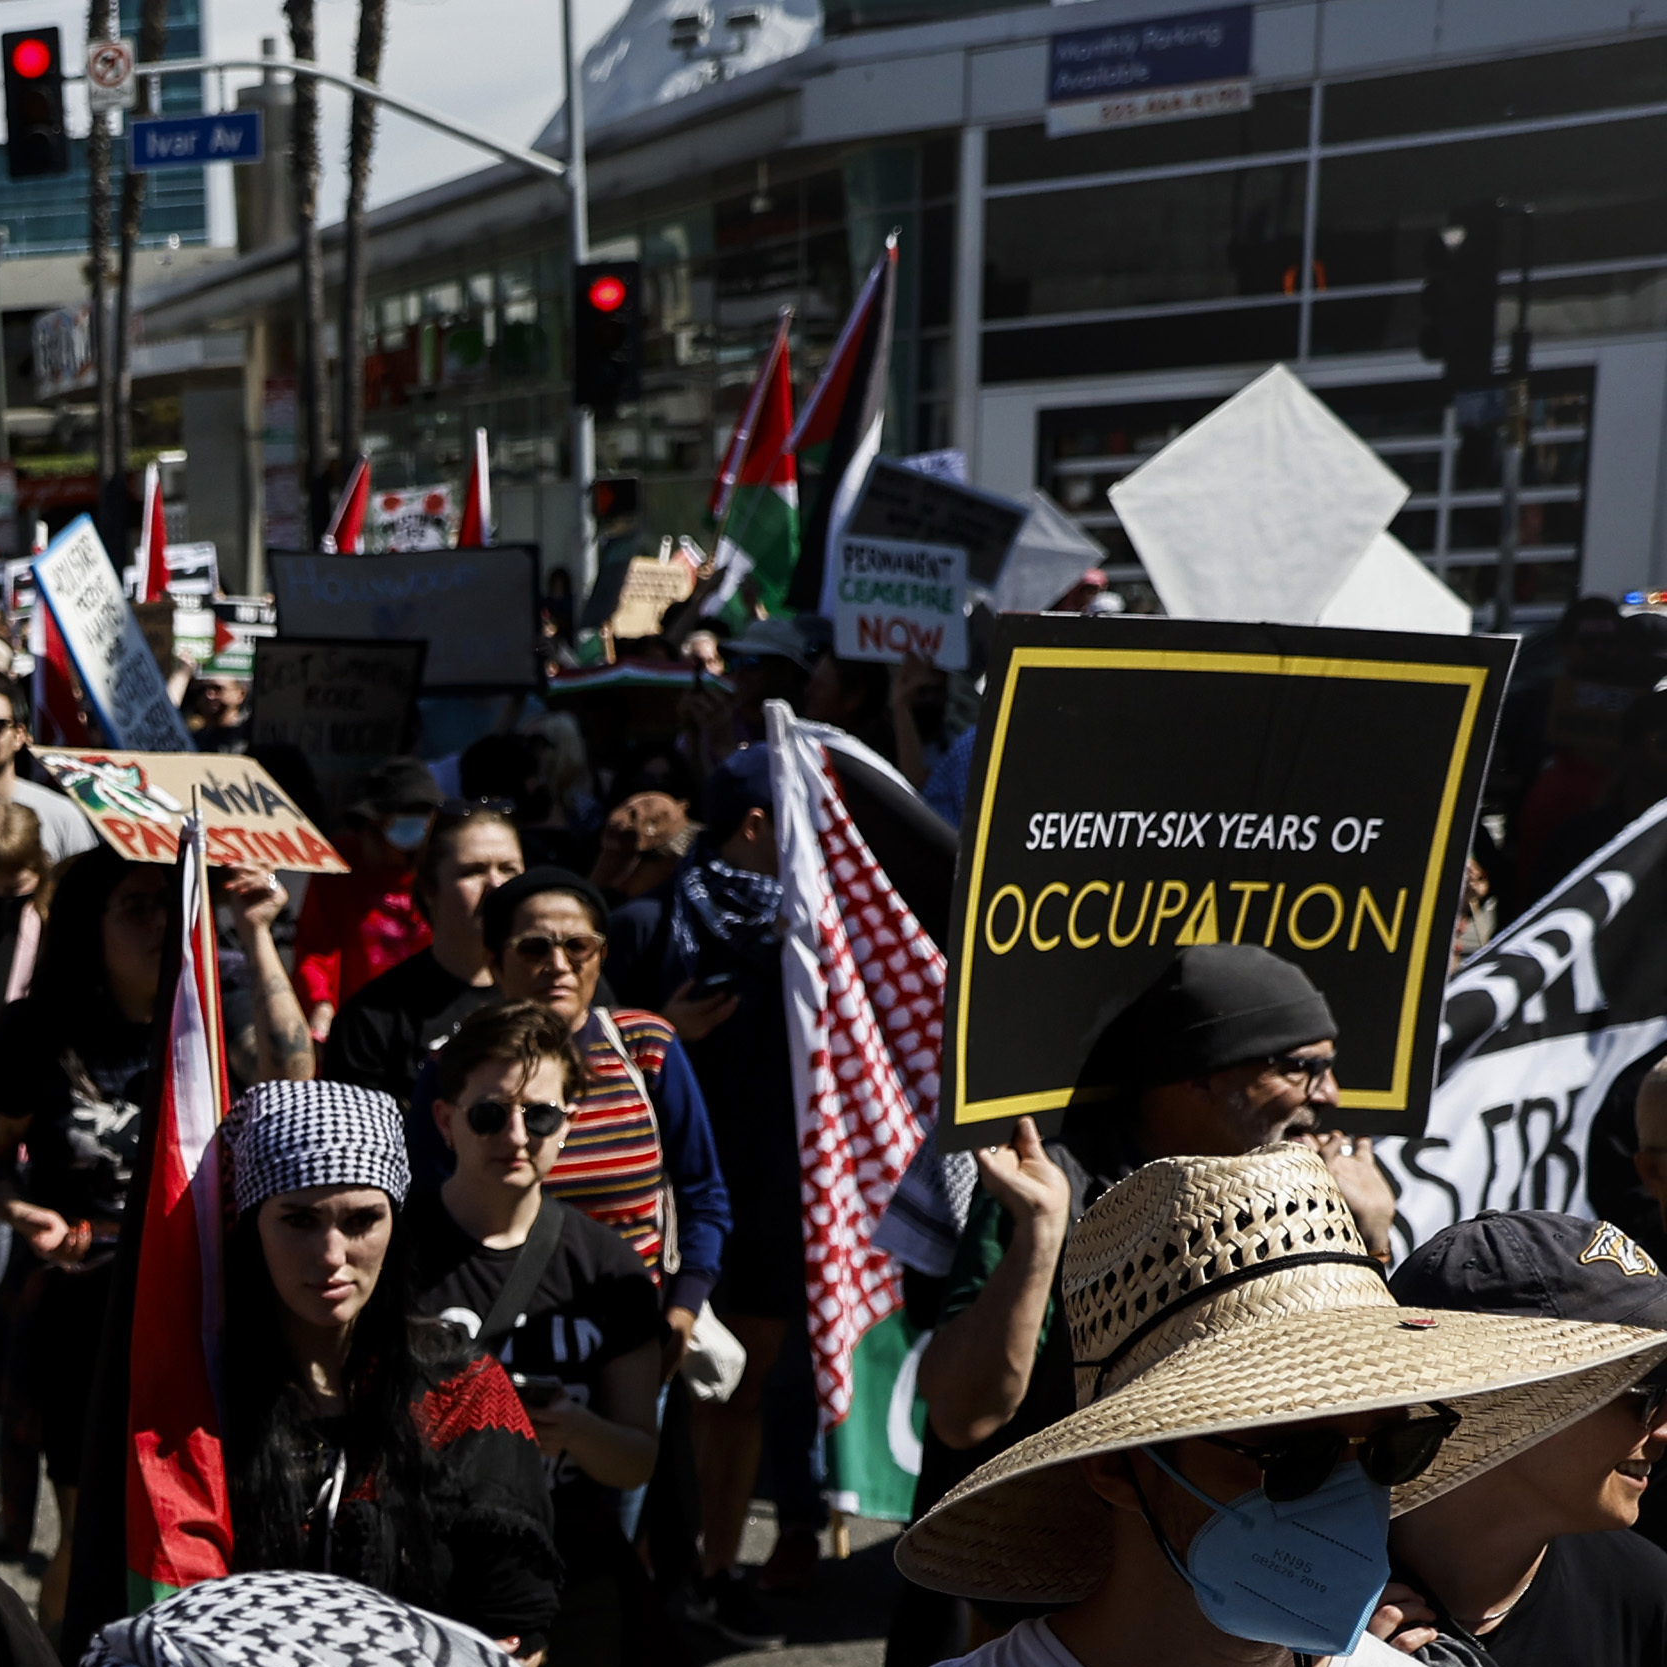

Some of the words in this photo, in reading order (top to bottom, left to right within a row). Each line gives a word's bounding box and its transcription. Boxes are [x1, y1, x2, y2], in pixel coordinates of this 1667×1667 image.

[145, 128, 200, 160] Ivar
[207, 122, 243, 154] Av
[843, 545, 952, 581] PERMANENT
[838, 579, 955, 614] CEASEFIRE
[857, 616, 945, 658] NOW
[1025, 811, 1211, 852] SEVENTY-SIX
[1216, 813, 1320, 853] YEARS
[1330, 816, 1384, 855] OF
[984, 878, 1409, 954] OCCUPATION
[1272, 1548, 1314, 1574] KN95
